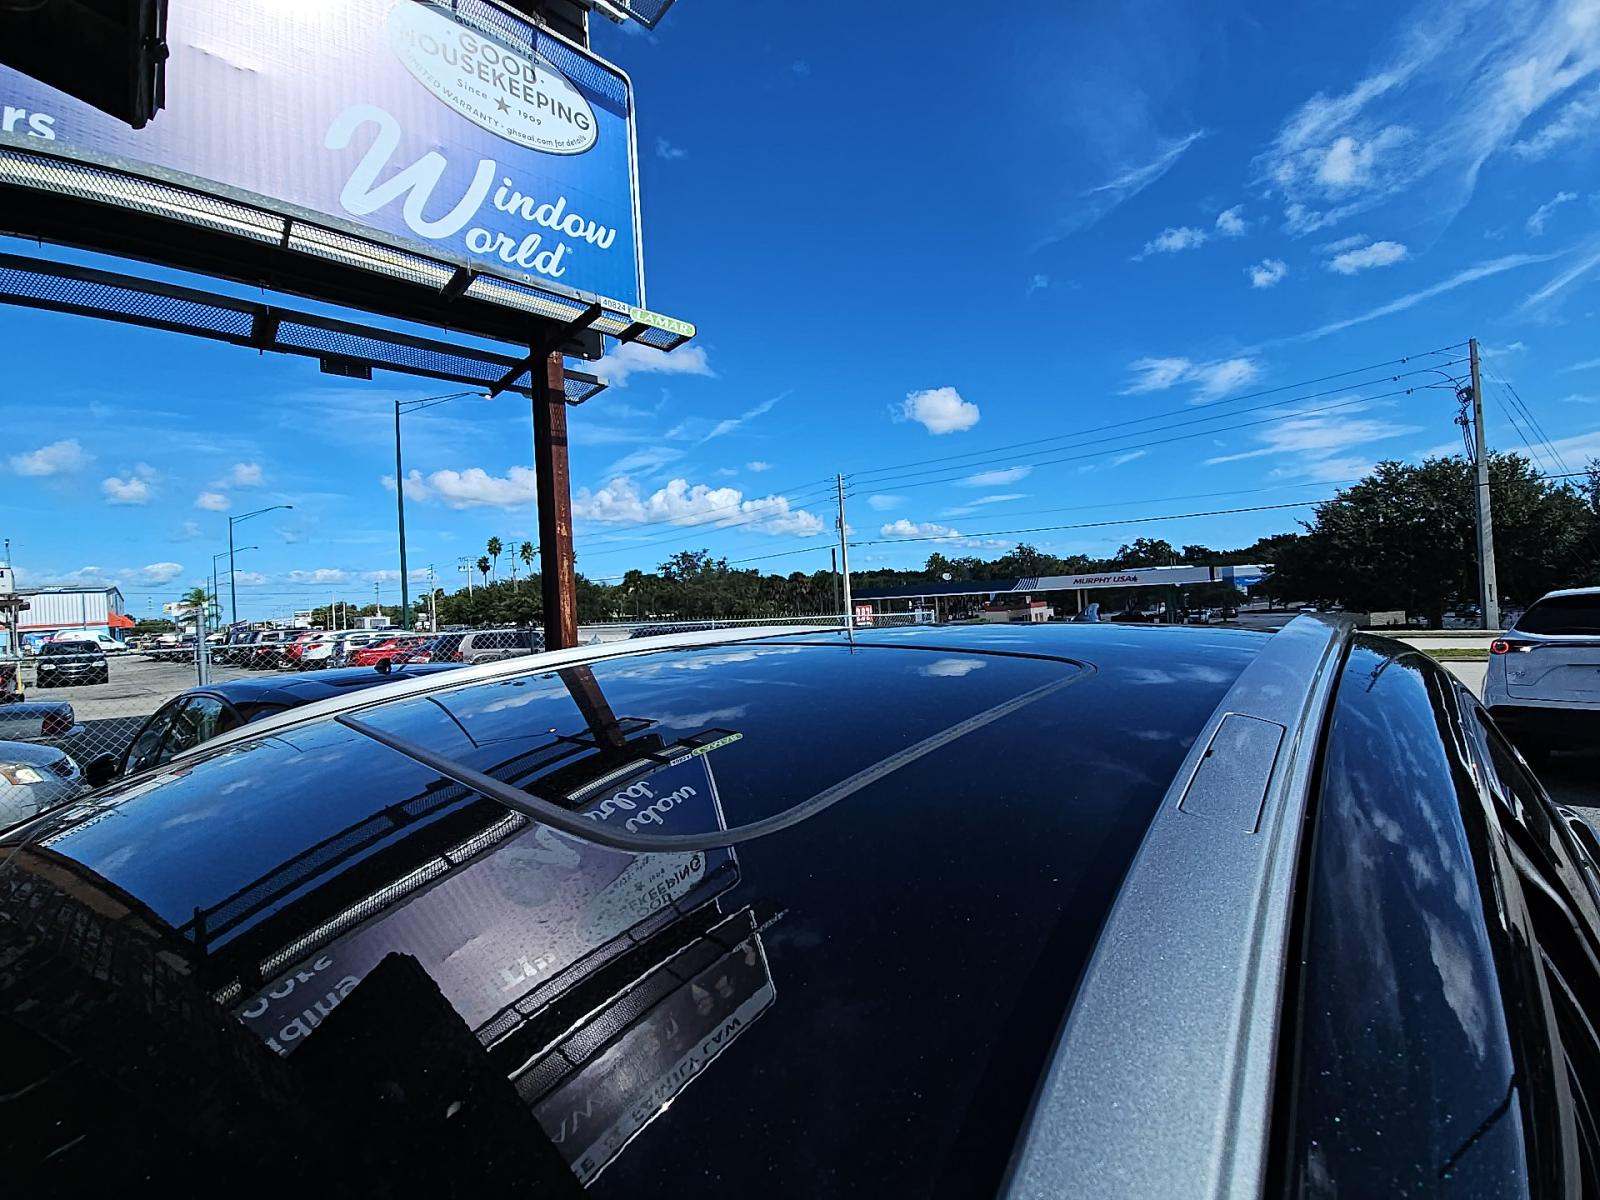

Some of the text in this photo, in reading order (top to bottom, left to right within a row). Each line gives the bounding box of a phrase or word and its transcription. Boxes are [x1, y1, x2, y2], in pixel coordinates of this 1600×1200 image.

[459, 32, 537, 85] GOOD
[402, 29, 590, 131] OUSEKEEPING
[456, 78, 488, 100] Since
[443, 86, 499, 127] WARRANTY
[554, 139, 565, 148] for
[566, 134, 587, 147] details
[518, 109, 542, 126] 1909
[636, 310, 689, 333] LAMAR
[1073, 575, 1132, 585] MURPHY USA
